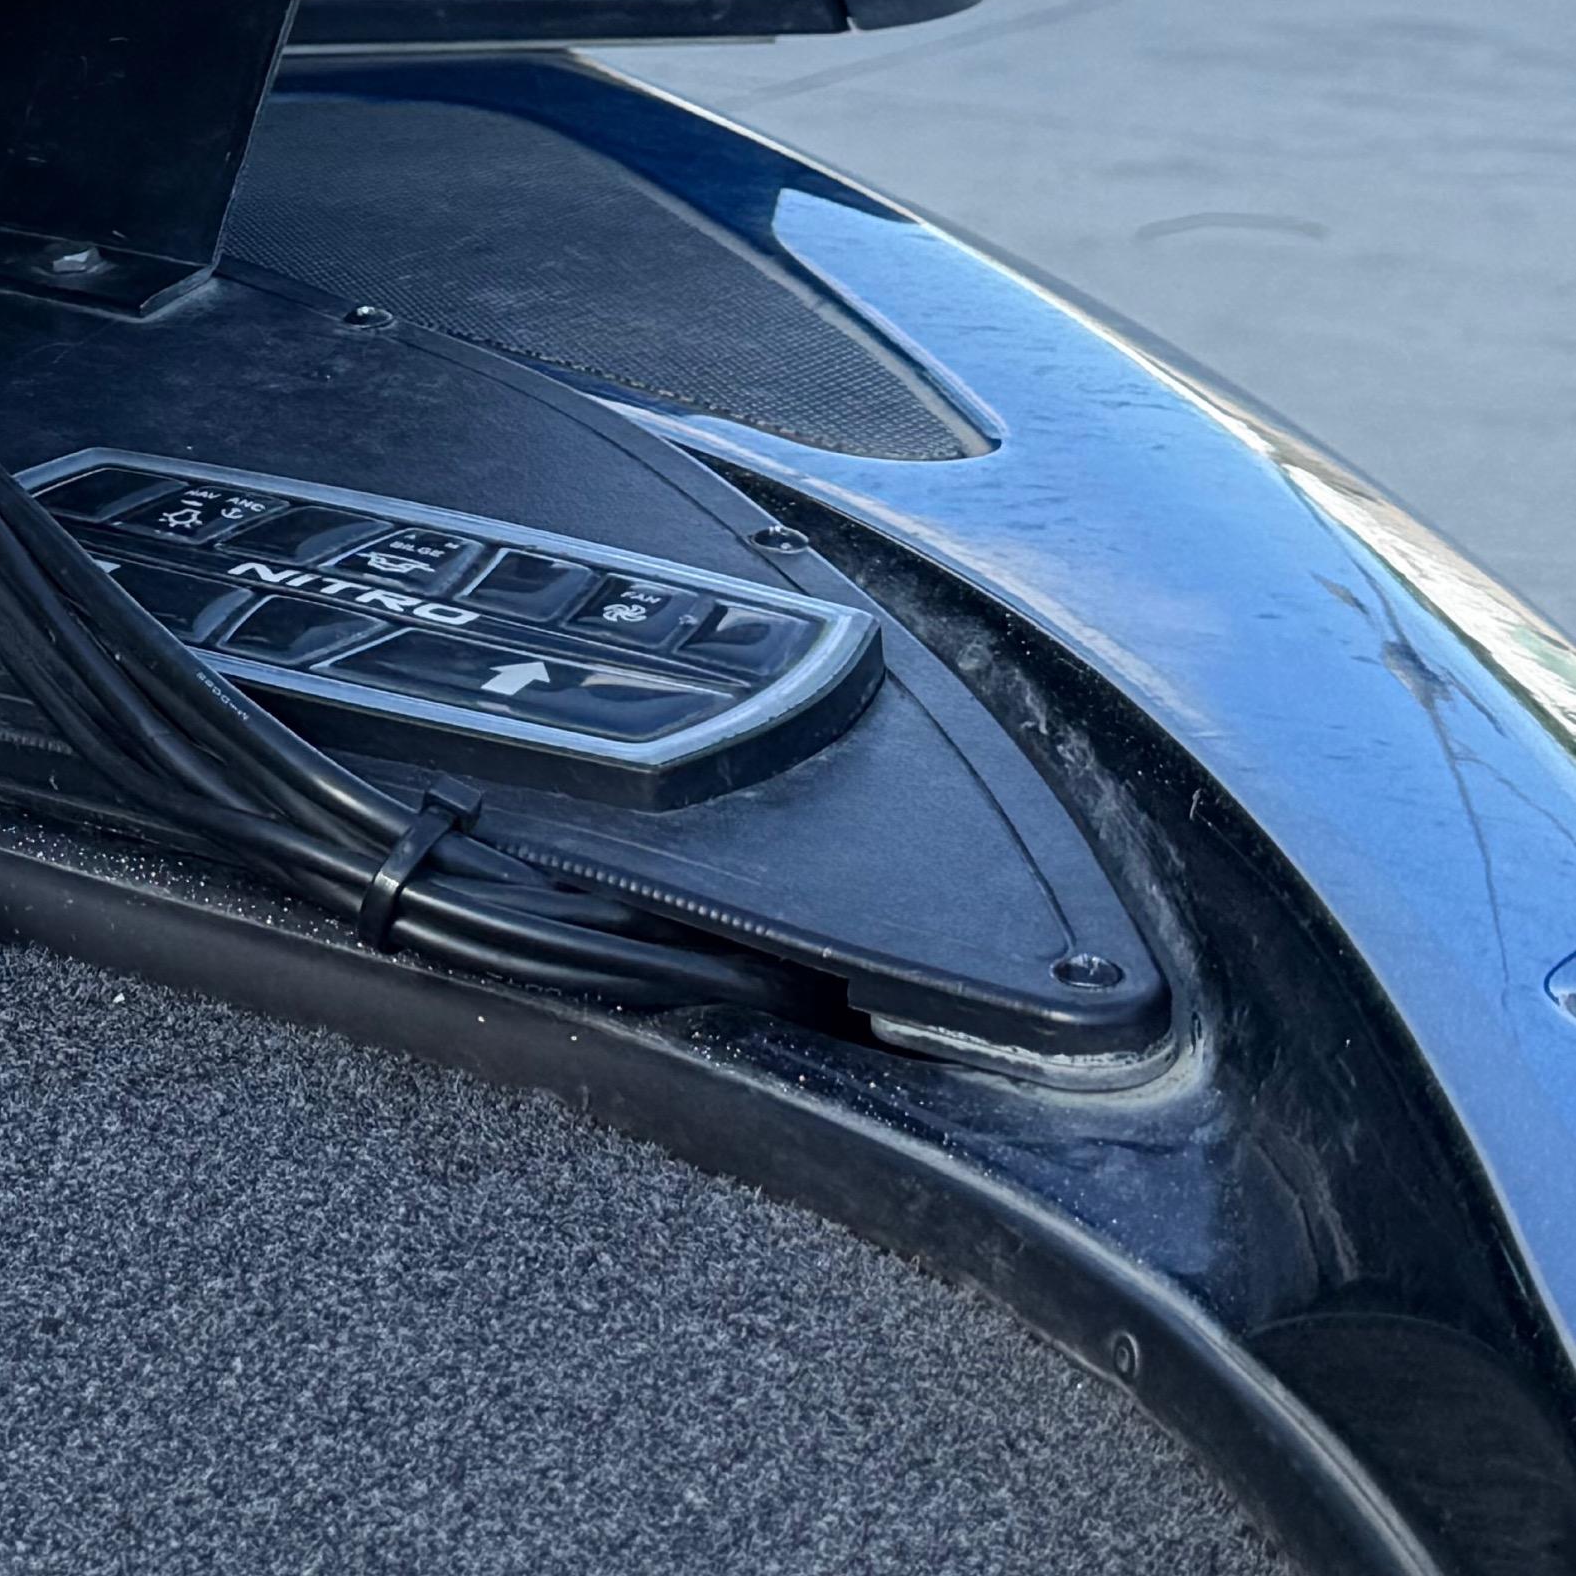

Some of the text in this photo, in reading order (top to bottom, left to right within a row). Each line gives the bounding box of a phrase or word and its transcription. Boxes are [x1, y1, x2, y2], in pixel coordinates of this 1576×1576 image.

[183, 489, 267, 513] NAV ANC
[389, 540, 445, 558] BILGE
[227, 561, 481, 626] NITRO
[619, 590, 662, 604] FAN
